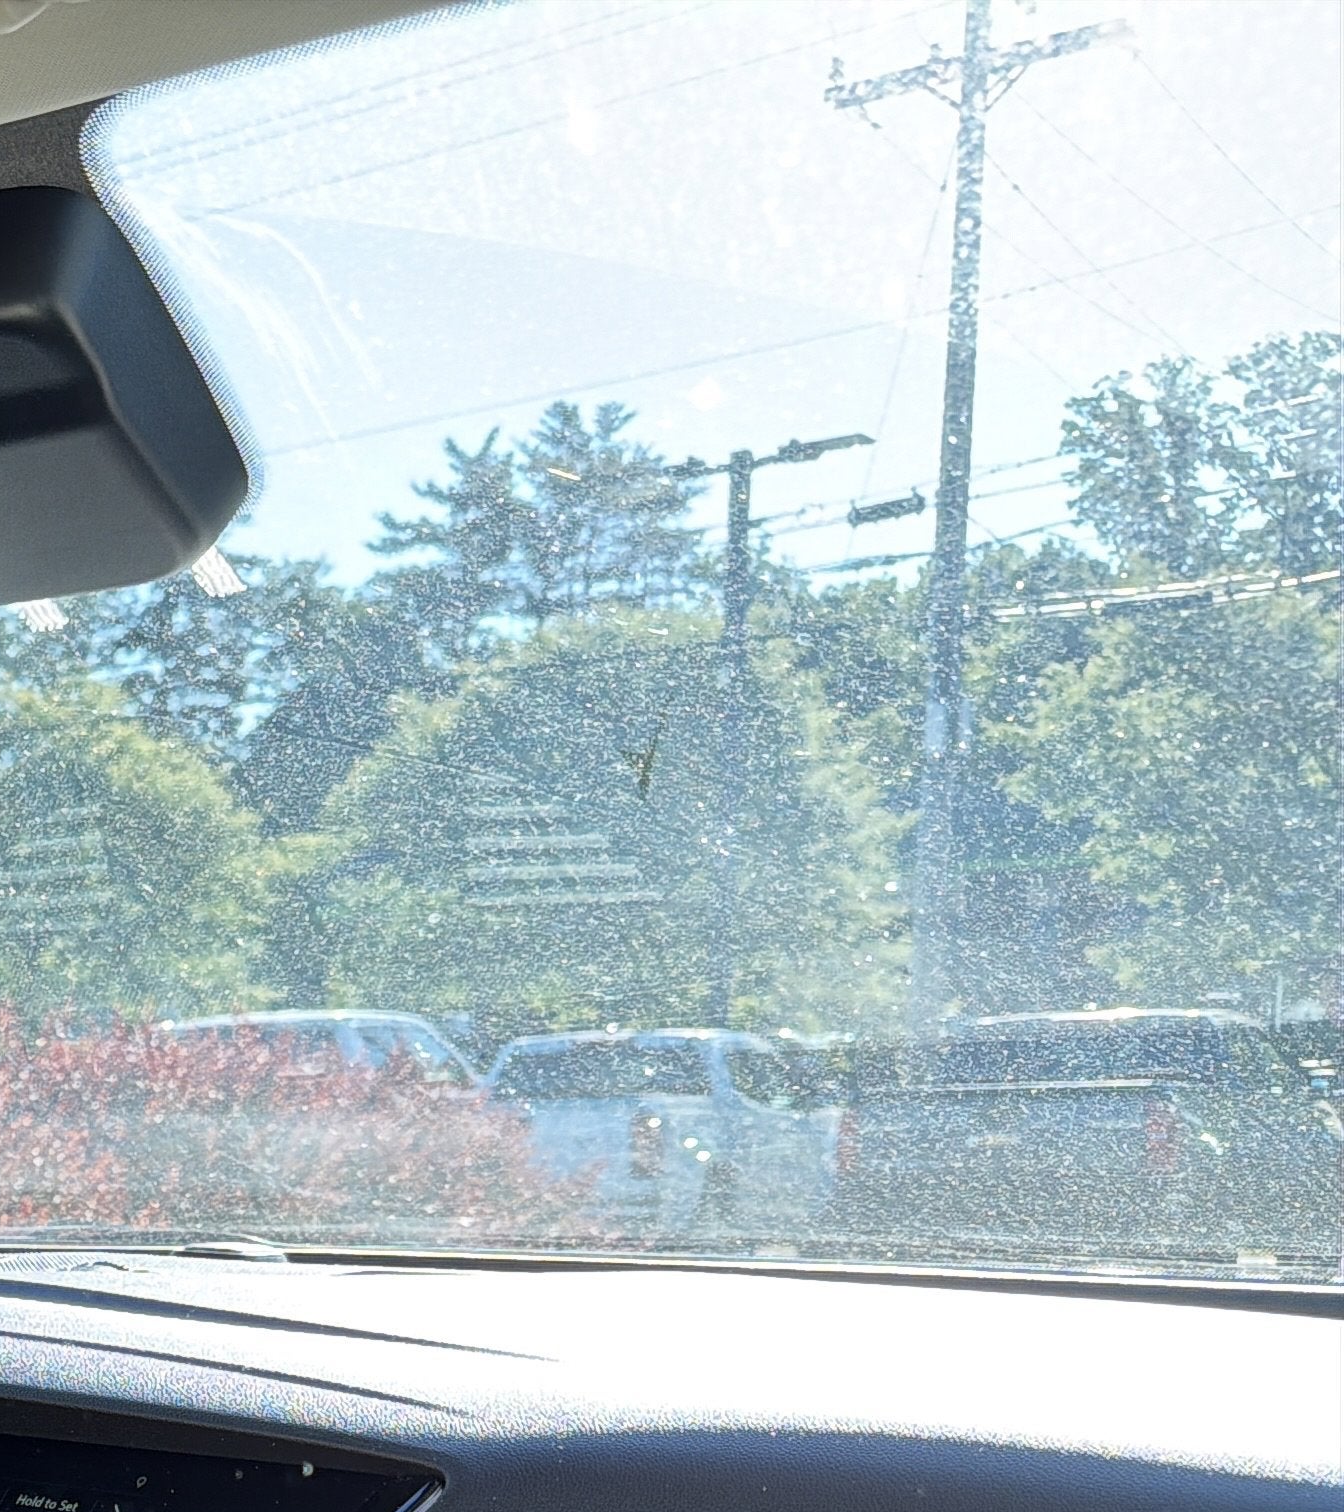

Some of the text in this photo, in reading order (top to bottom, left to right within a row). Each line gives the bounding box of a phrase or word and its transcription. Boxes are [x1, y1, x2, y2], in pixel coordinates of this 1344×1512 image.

[16, 1494, 79, 1512] Hold to Set
